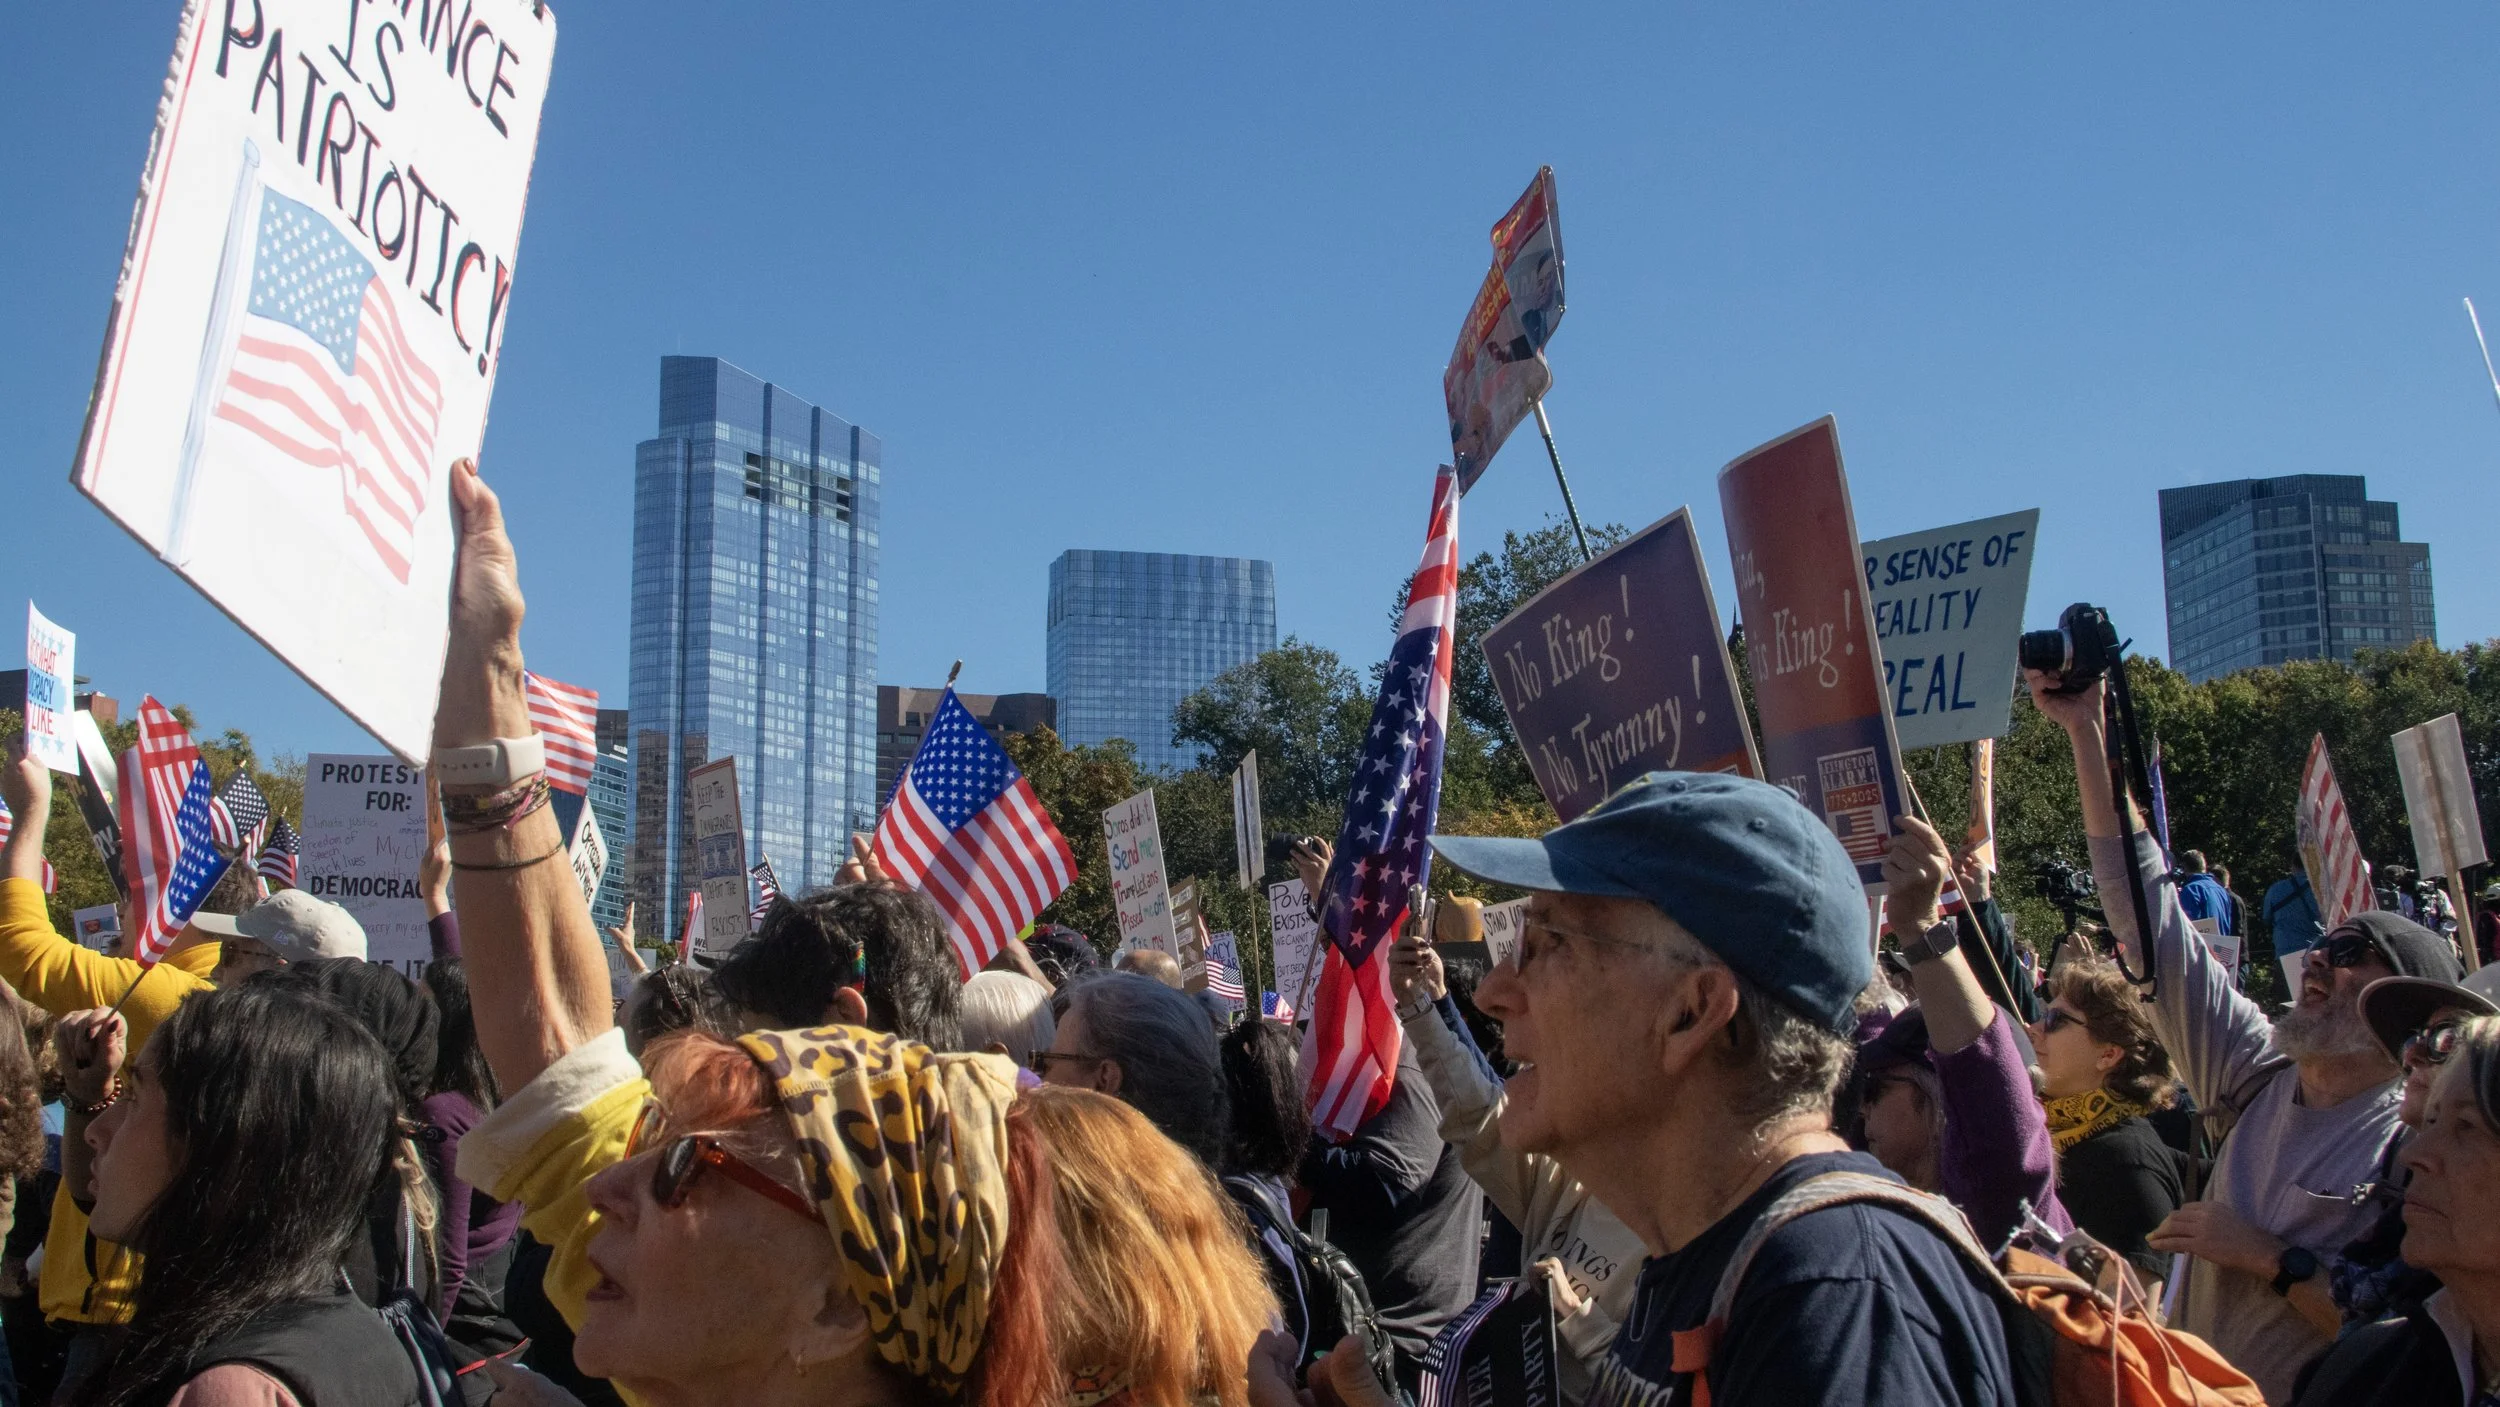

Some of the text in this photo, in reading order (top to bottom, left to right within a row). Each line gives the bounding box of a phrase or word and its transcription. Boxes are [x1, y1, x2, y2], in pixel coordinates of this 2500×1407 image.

[328, 0, 405, 112] IS
[215, 0, 511, 377] PATRIOTIC!
[1884, 539, 1972, 587] SENSE
[1983, 530, 2026, 568] OF
[1504, 574, 1635, 713] No King!
[1773, 588, 1854, 690] King!
[1873, 586, 1982, 639] EALITY
[321, 763, 420, 785] PROTEST
[1540, 654, 1706, 804] No Tyranny!
[365, 790, 412, 813] FOR:
[1112, 835, 1139, 871] Send
[1521, 1316, 1547, 1407] PARTY
